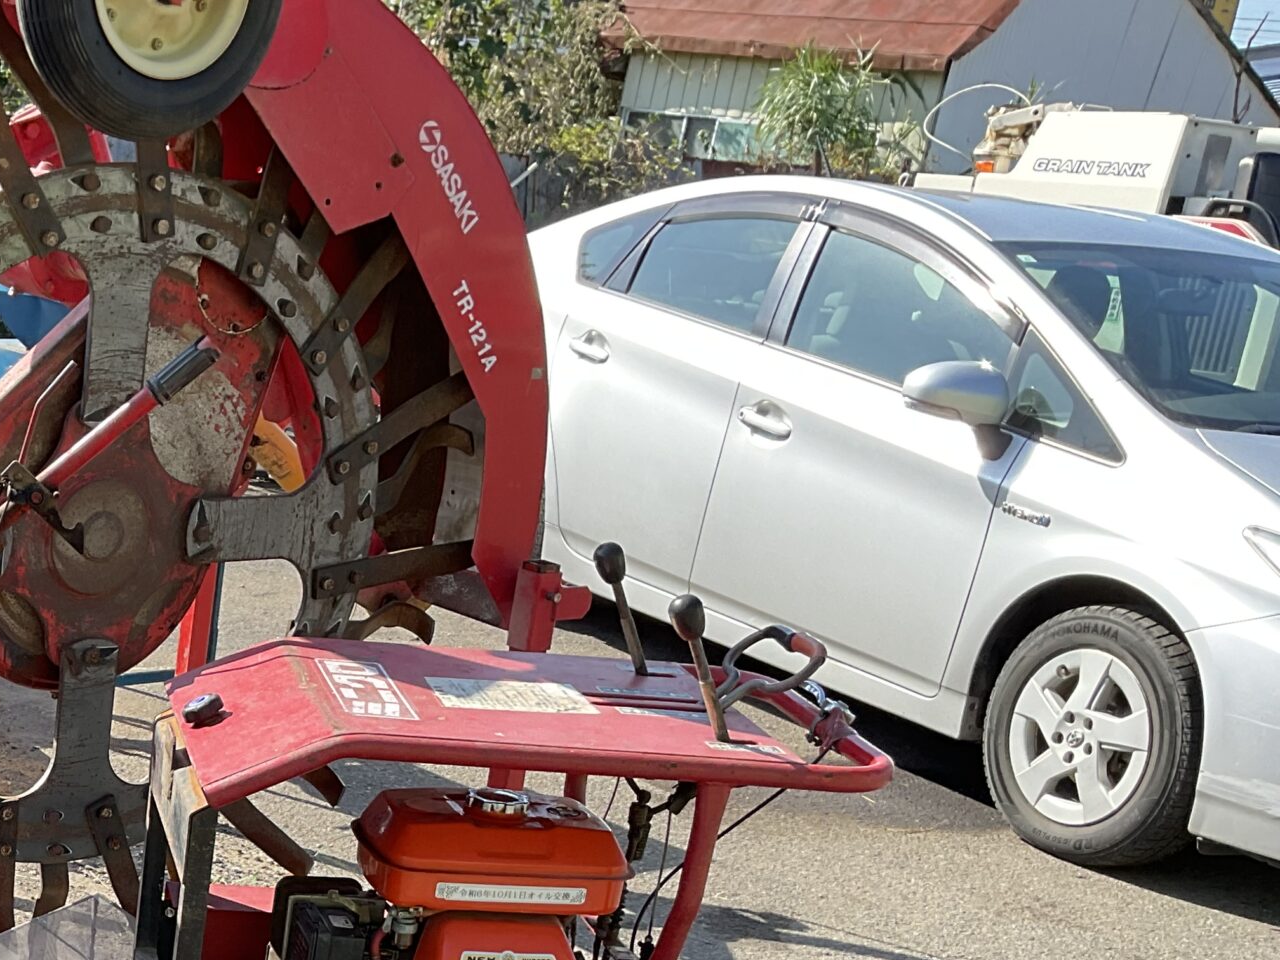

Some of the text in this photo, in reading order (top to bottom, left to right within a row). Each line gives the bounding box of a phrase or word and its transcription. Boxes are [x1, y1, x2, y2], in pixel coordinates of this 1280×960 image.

[431, 145, 479, 234] SASAKI
[1033, 158, 1151, 177] GRAIN TANK
[453, 280, 497, 372] TR-121A
[1050, 622, 1119, 641] YOKOHAMA
